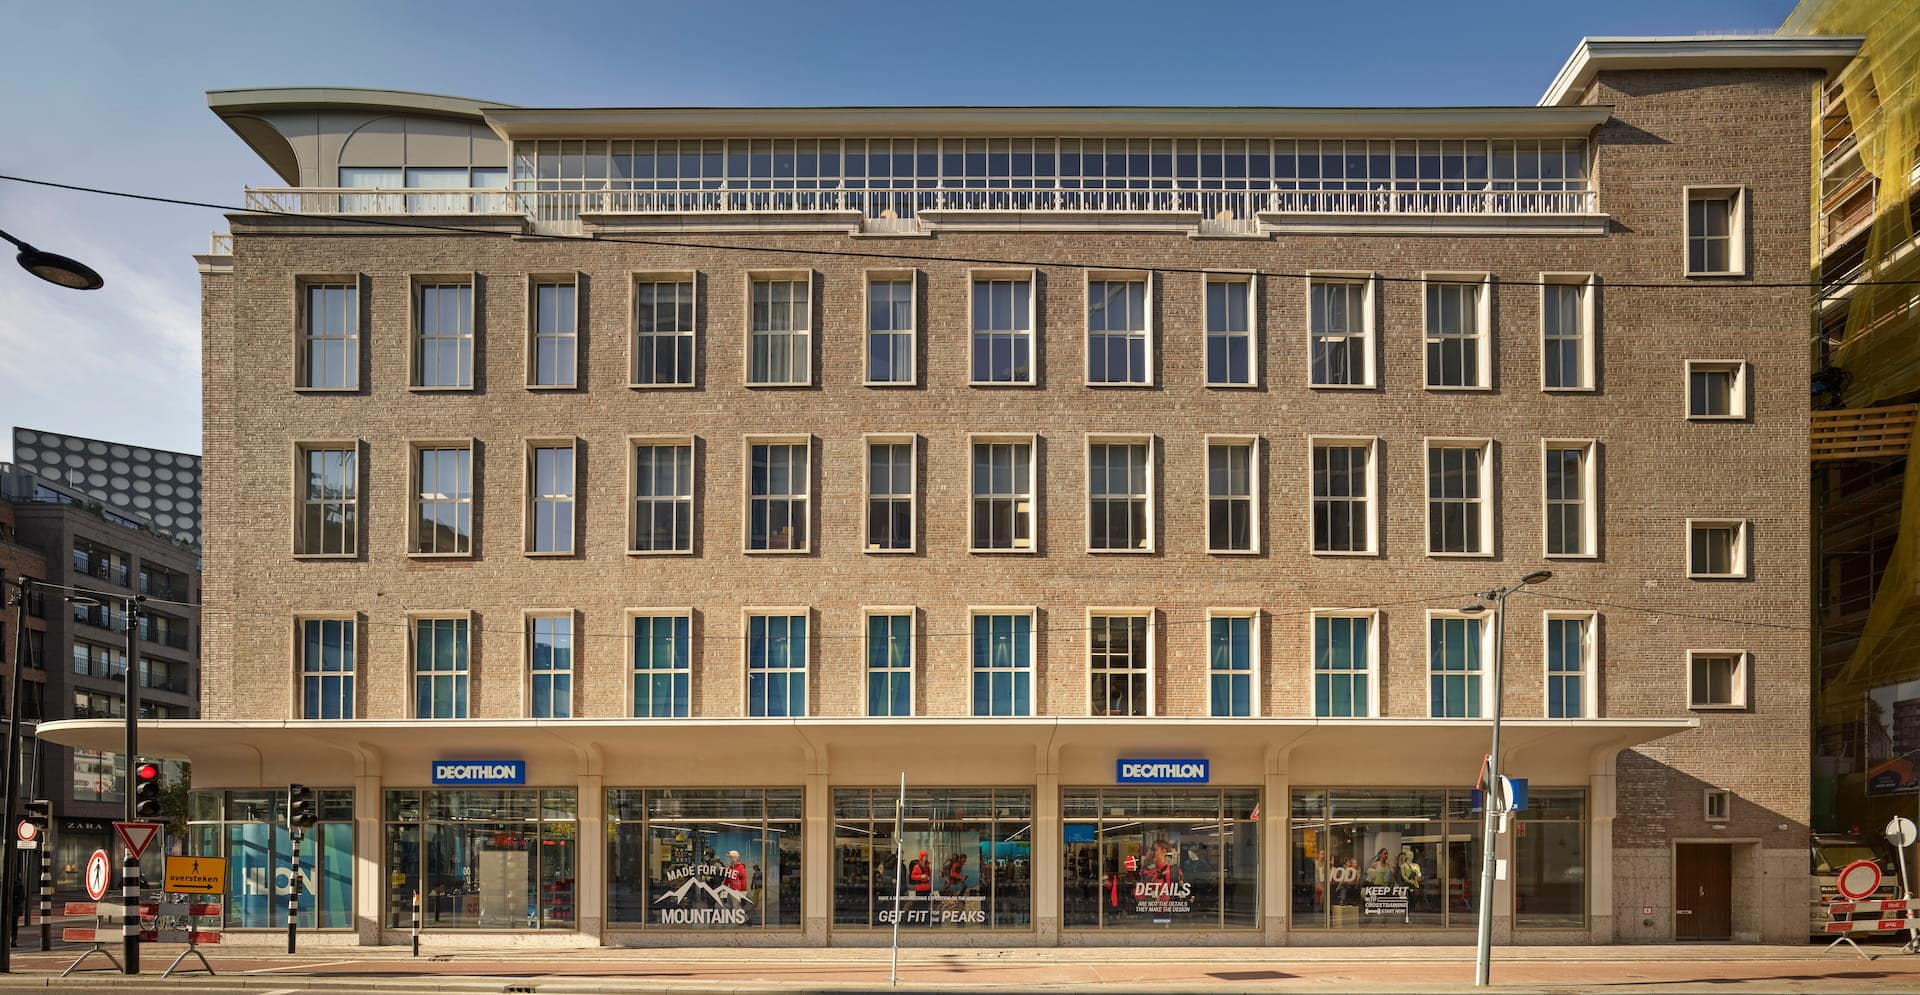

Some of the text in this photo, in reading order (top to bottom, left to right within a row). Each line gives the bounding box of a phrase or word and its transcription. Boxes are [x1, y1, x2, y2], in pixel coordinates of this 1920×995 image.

[436, 765, 516, 779] DECATHLON
[1122, 764, 1204, 778] DECATHLON
[67, 822, 103, 830] ZARA
[169, 874, 218, 882] oversteken
[666, 865, 739, 882] MADE FOR THE
[1135, 882, 1191, 896] DETAILS
[1365, 886, 1409, 895] KEEP FIT
[661, 908, 746, 924] MOUNTAINS
[878, 910, 986, 923] GET FIT PEAKS
